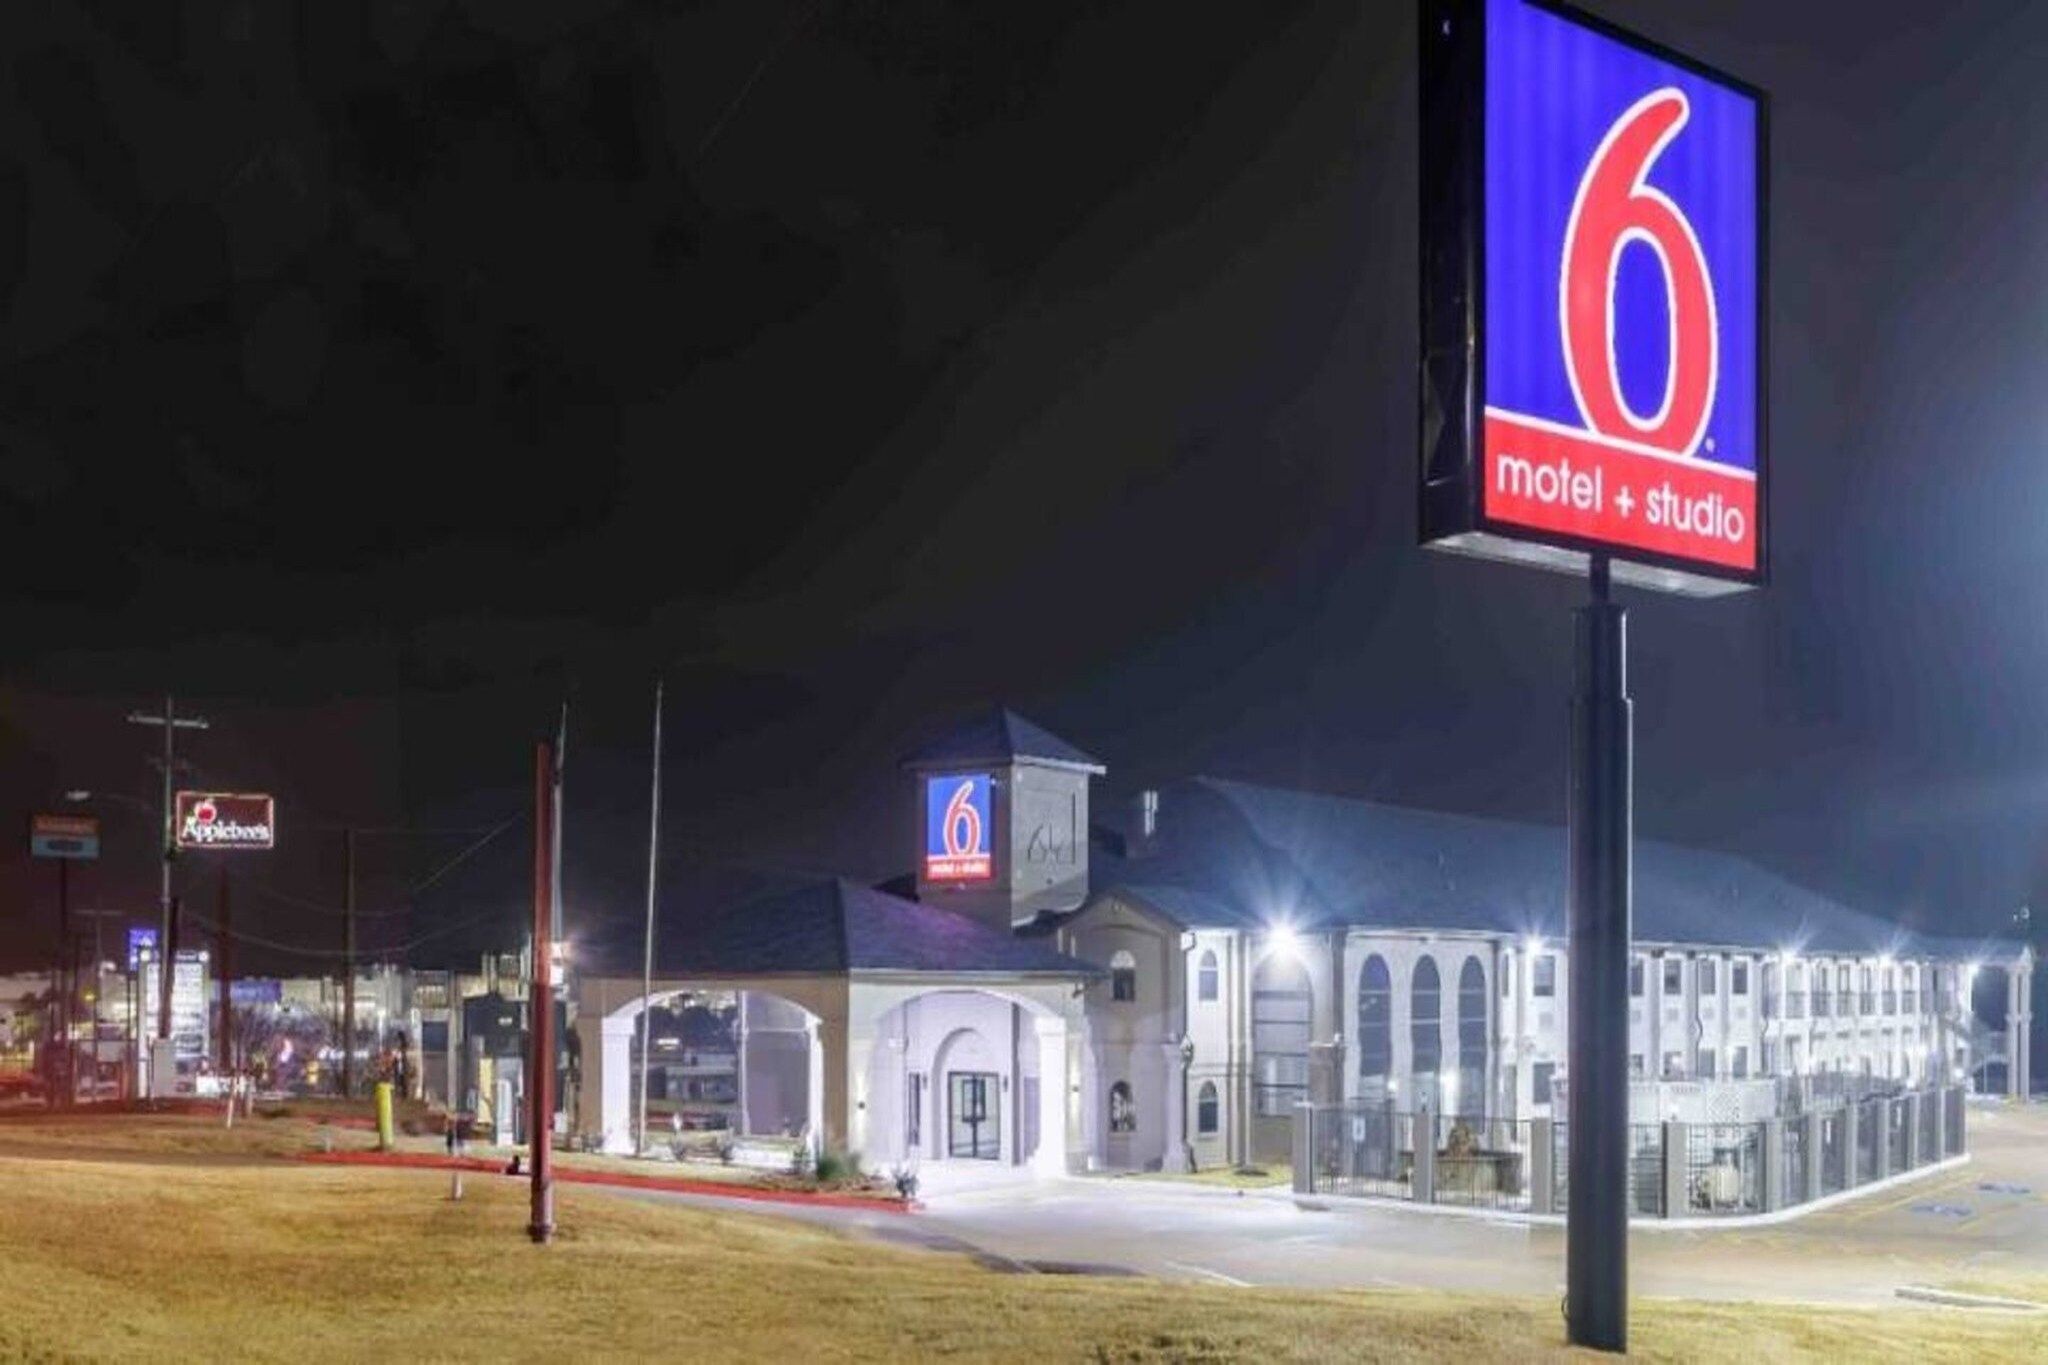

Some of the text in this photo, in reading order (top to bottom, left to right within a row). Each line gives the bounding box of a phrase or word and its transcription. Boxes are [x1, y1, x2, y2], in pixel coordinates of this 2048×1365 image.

[1560, 87, 1718, 456] 6
[1496, 453, 1602, 512] motel
[1646, 481, 1745, 543] studio
[942, 780, 981, 857] 6
